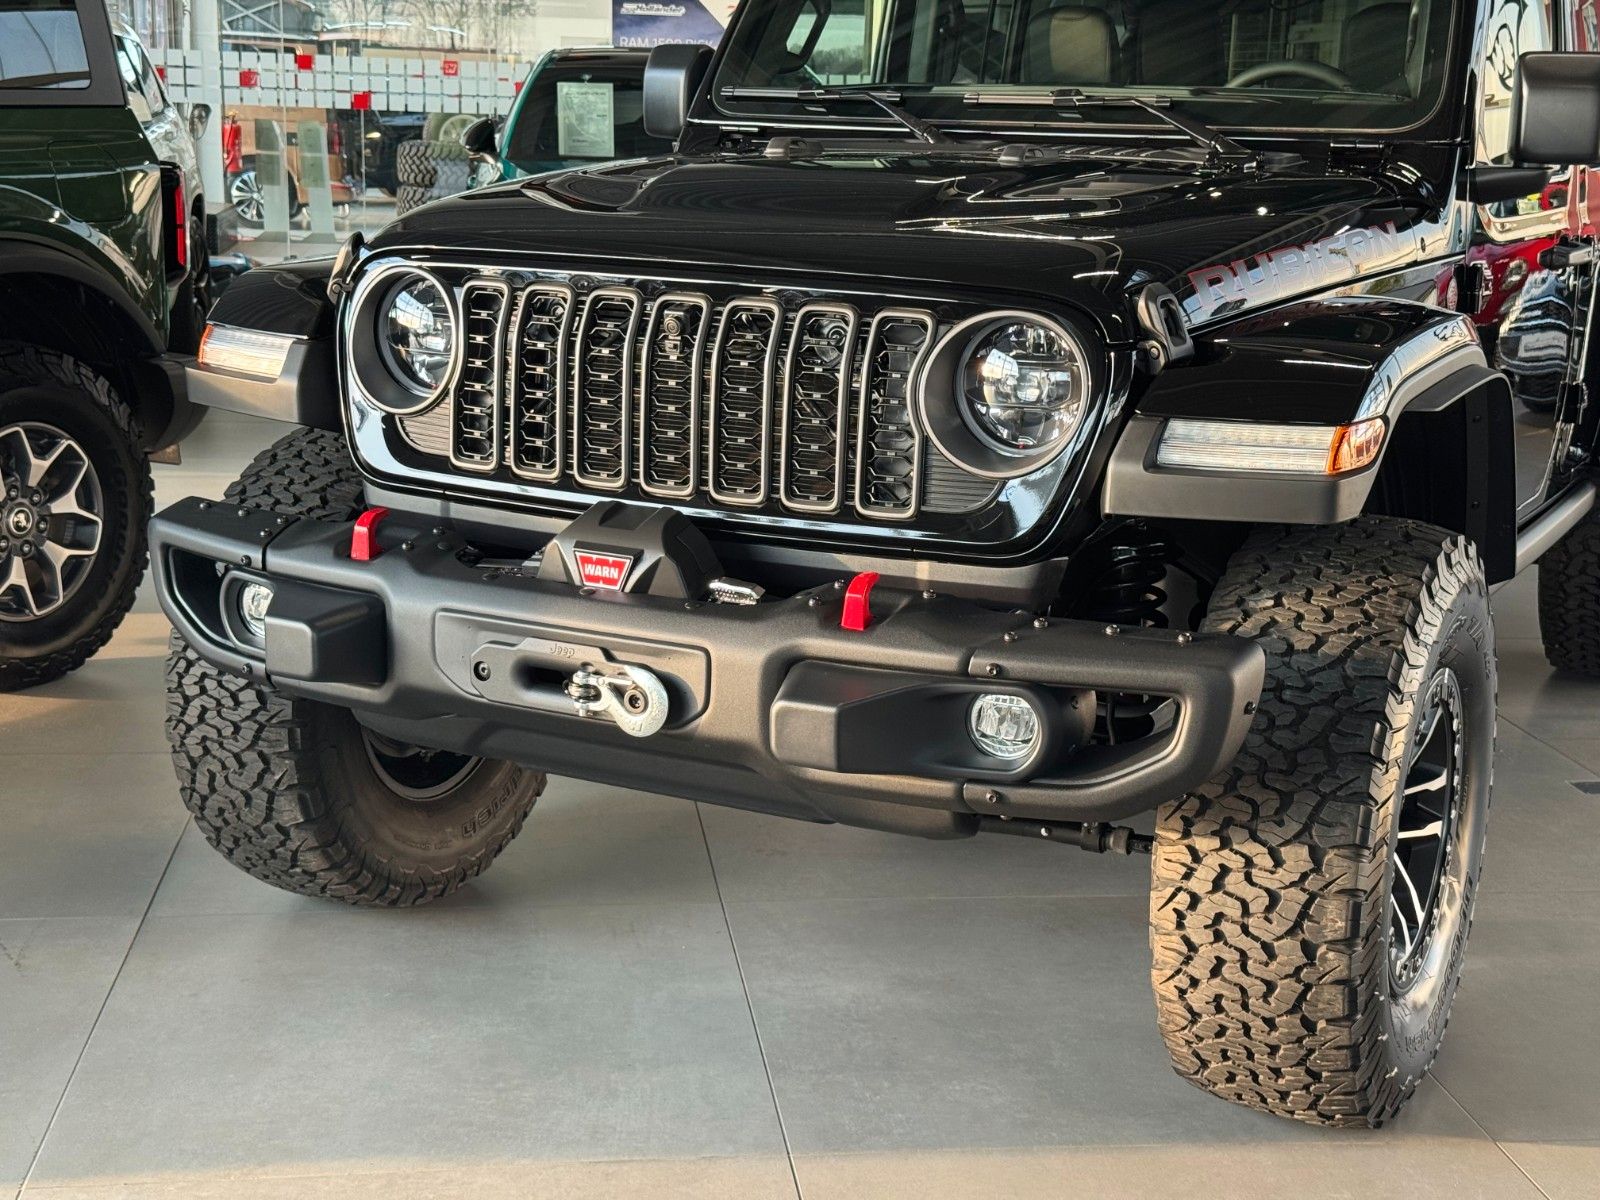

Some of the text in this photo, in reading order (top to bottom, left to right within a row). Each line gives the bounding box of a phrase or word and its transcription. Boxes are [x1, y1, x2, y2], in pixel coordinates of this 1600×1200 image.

[620, 37, 649, 47] RAM
[1187, 221, 1400, 303] RUBICON
[584, 563, 619, 579] WARN
[550, 643, 575, 659] Jeep
